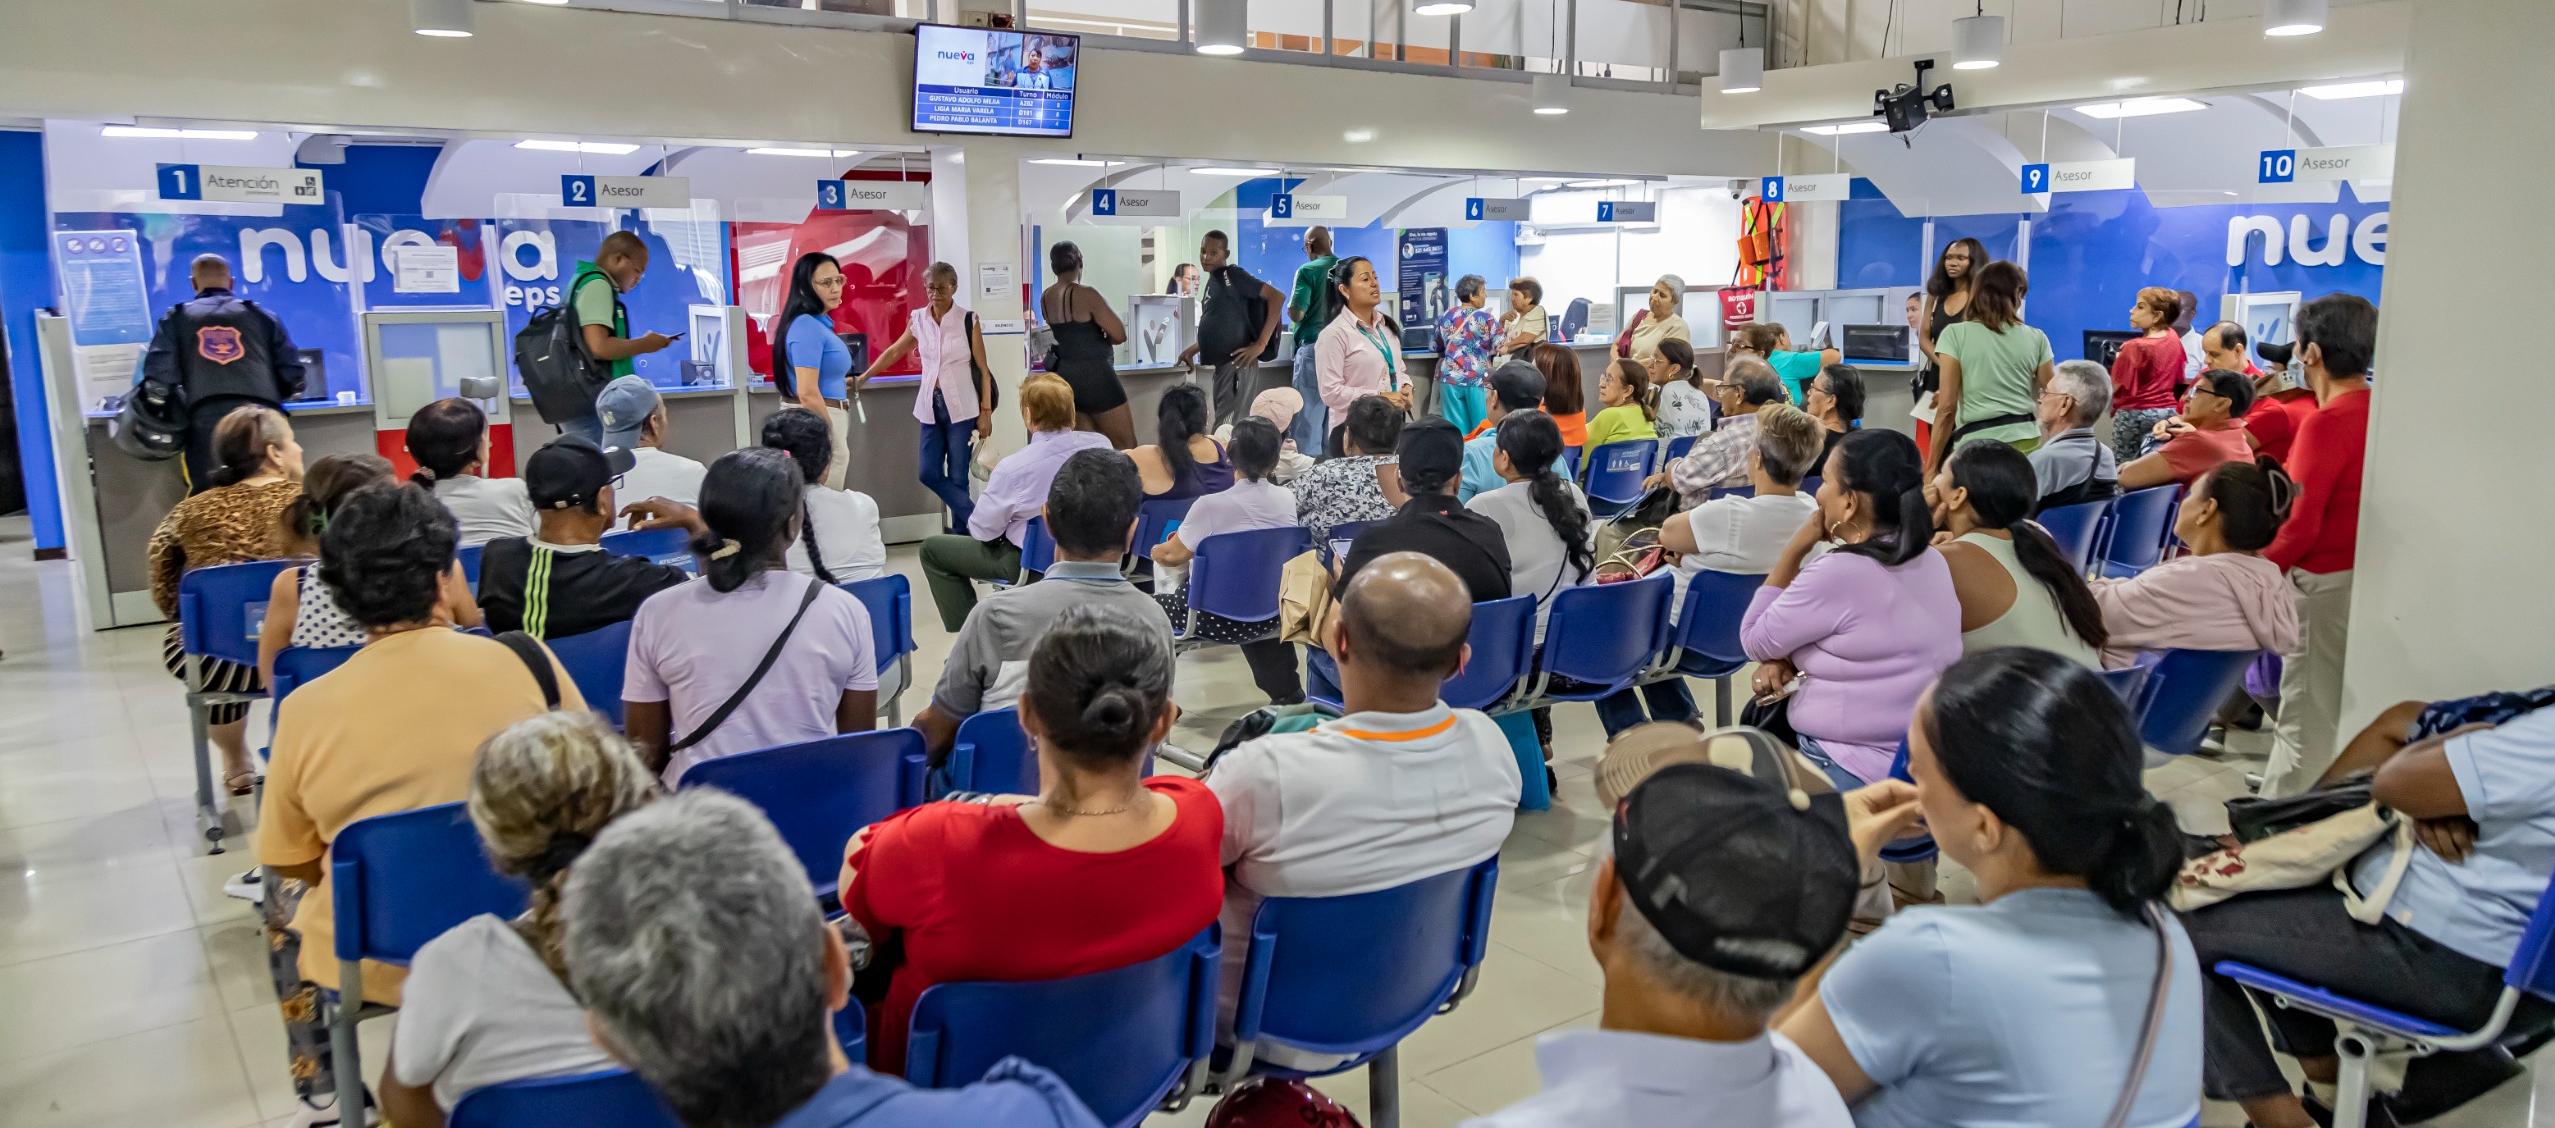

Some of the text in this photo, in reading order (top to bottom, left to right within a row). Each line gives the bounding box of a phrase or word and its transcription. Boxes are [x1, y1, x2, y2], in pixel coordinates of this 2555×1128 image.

[938, 50, 975, 61] nueva
[929, 95, 957, 103] GUSTAVO
[954, 87, 979, 95] Usuario
[1046, 92, 1069, 100] Módulo
[2263, 155, 2351, 178] 10 Asesor
[172, 170, 280, 194] 1 Atención
[2029, 169, 2093, 189] 9 Asesor
[571, 180, 645, 202] 2 Asesor
[825, 185, 888, 205] 3 Asesor
[1767, 180, 1817, 198] 8 Asesor
[1098, 193, 1149, 211] 4 Asesor
[1277, 198, 1321, 214] 5 Asesor
[1470, 201, 1508, 217] 6 Asesor
[1601, 204, 1609, 219] 7
[504, 286, 561, 313] eps
